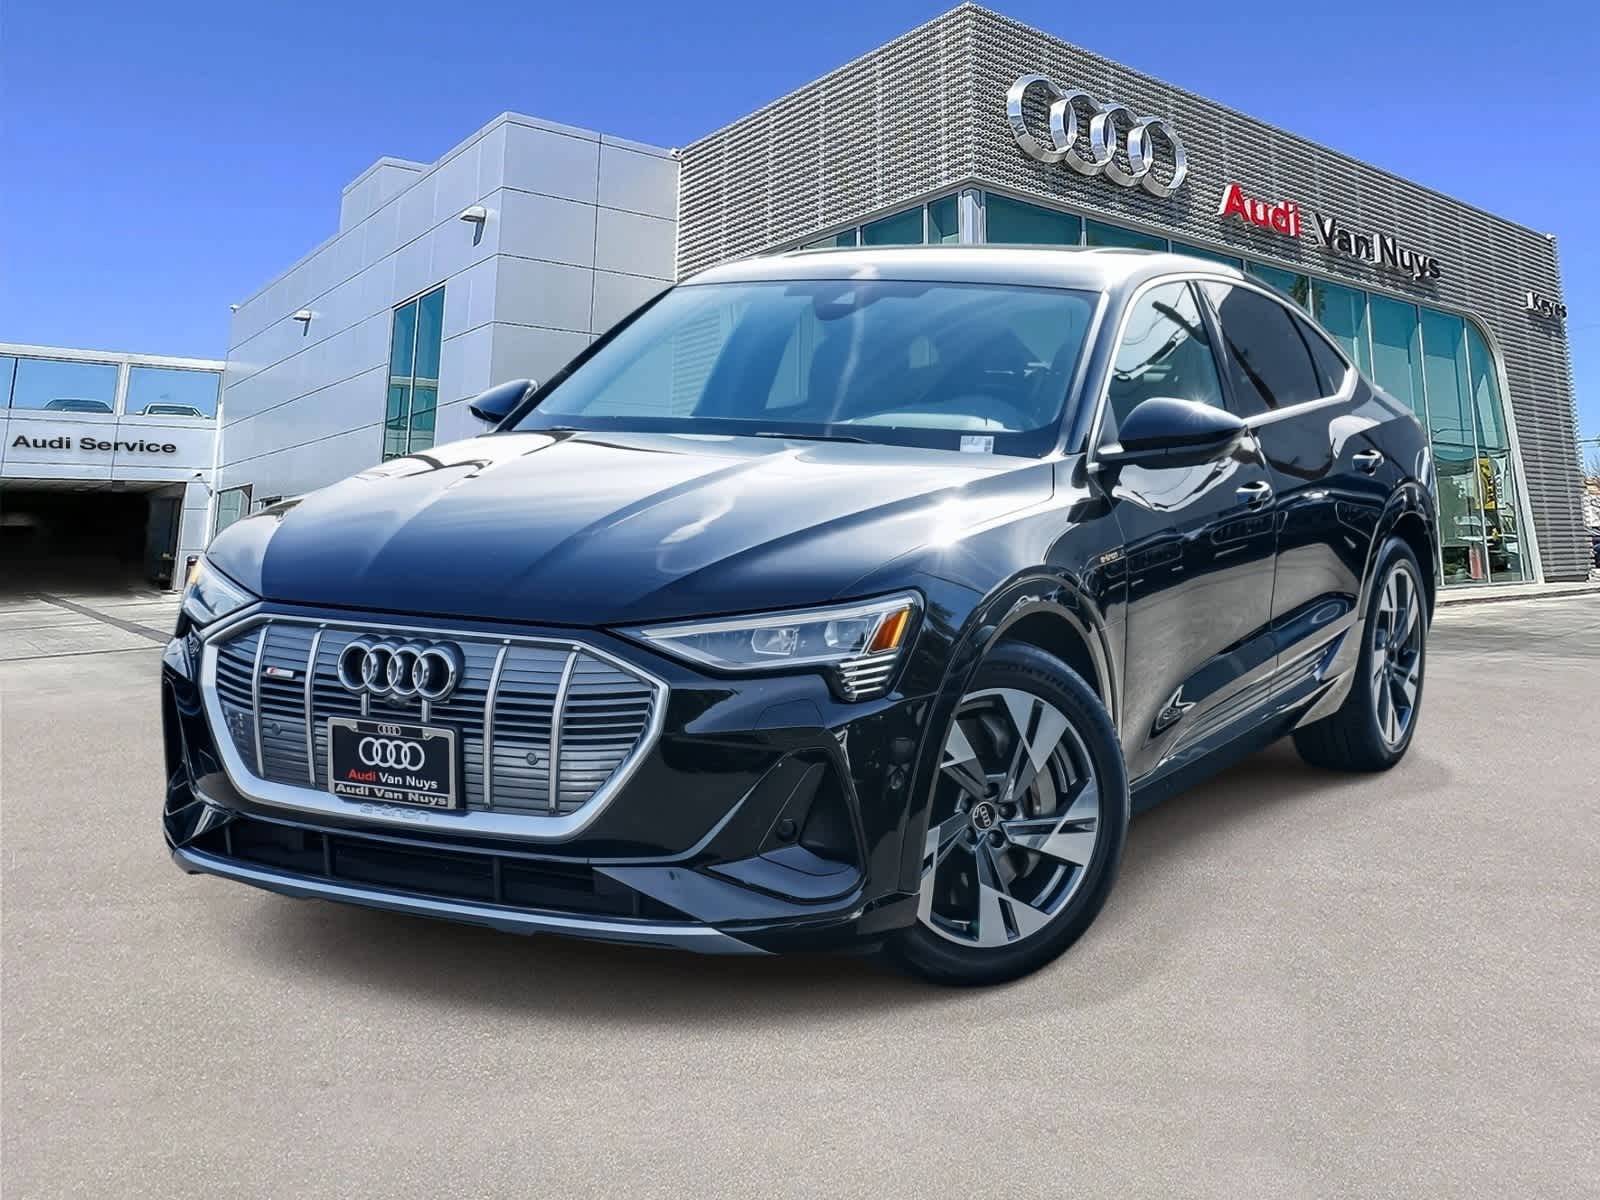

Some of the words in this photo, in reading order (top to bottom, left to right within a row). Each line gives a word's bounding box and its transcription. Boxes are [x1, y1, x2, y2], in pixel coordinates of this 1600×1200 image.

[1218, 182, 1302, 238] Audi
[1312, 212, 1370, 259] Van
[1372, 233, 1441, 281] Nuys
[1527, 291, 1568, 318] Keyes
[12, 435, 71, 449] Audi
[80, 437, 177, 453] Service
[348, 768, 377, 781] Audi
[379, 772, 403, 785] Van
[406, 775, 438, 790] Nuys
[336, 783, 369, 796] Audi
[374, 787, 403, 800] Van
[408, 792, 448, 806] Nuys
